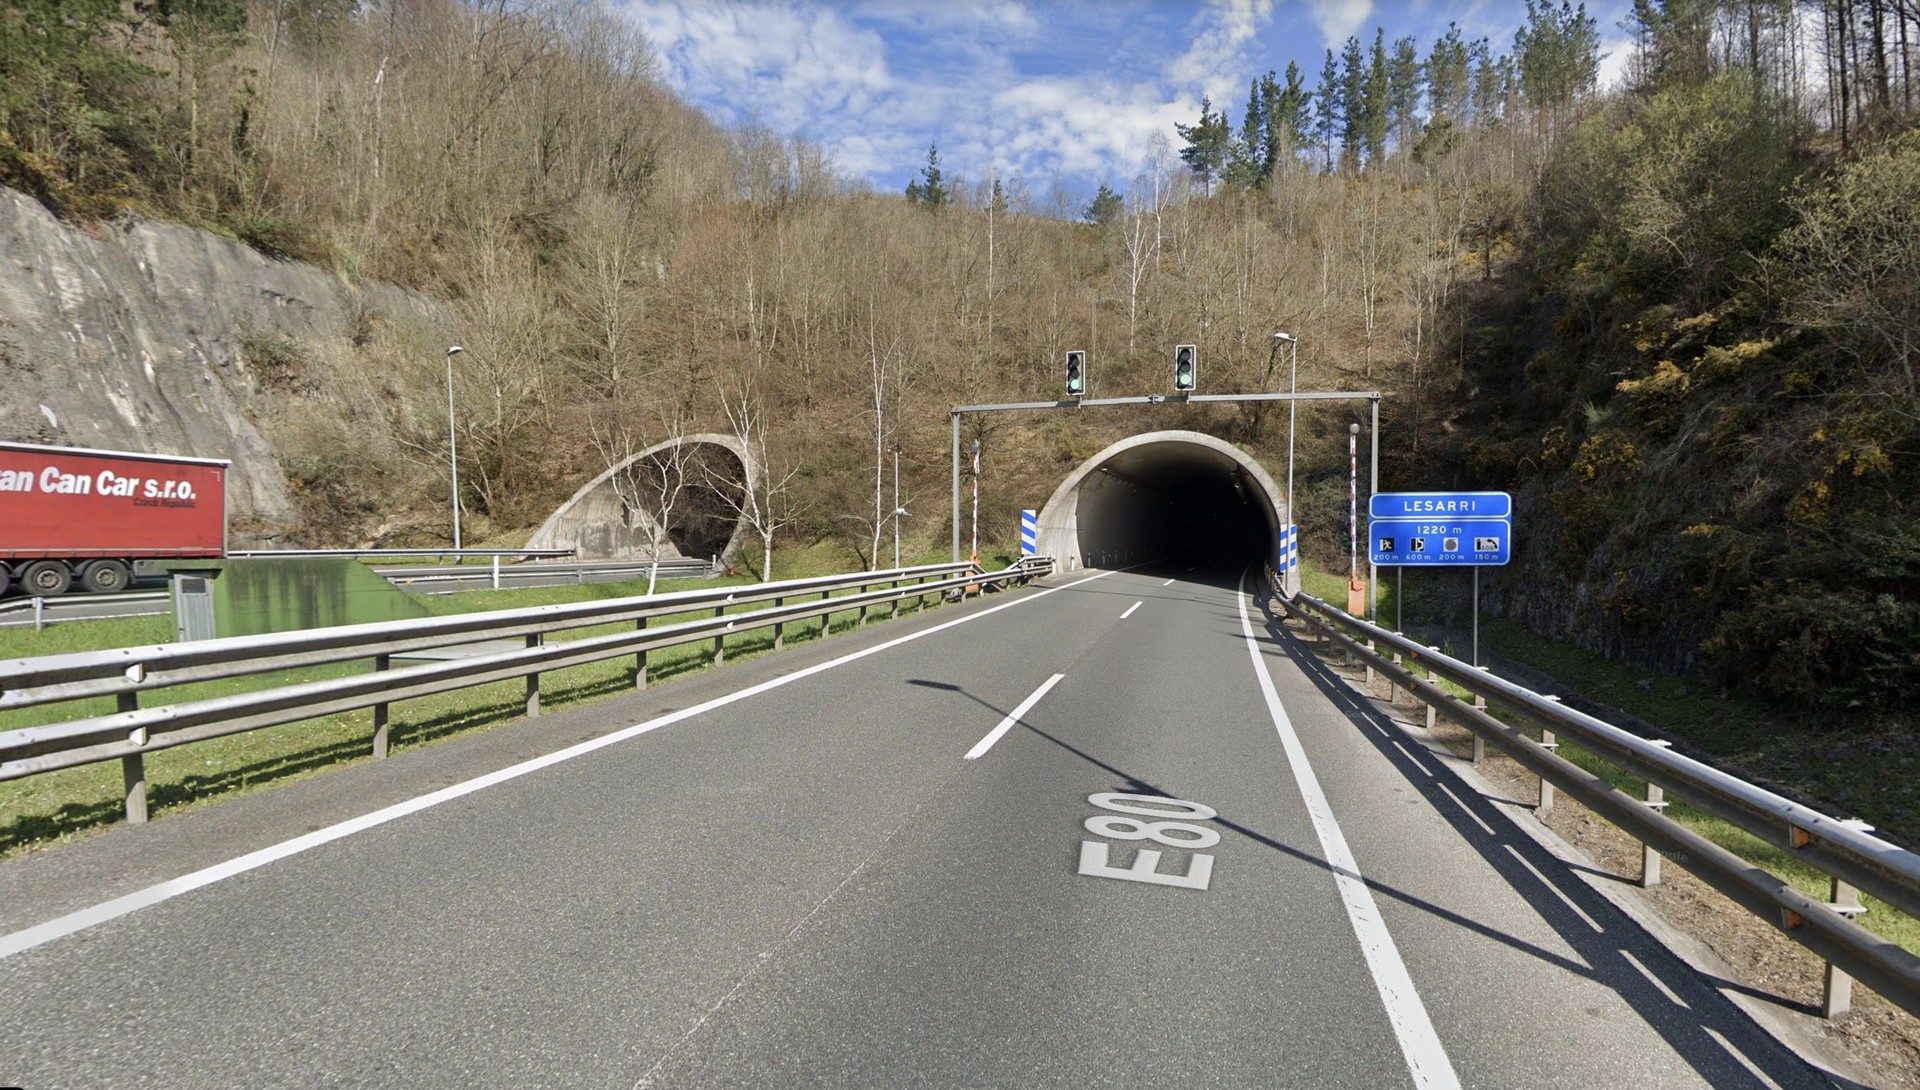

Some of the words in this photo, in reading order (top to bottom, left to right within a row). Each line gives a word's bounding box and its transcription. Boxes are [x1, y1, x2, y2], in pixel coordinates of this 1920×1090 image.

[40, 466, 91, 494] Can
[97, 470, 139, 496] Car
[144, 479, 196, 499] s.r.o.
[133, 497, 159, 507] Czech
[1404, 500, 1476, 512] LESARRI
[1417, 525, 1447, 534] 1220
